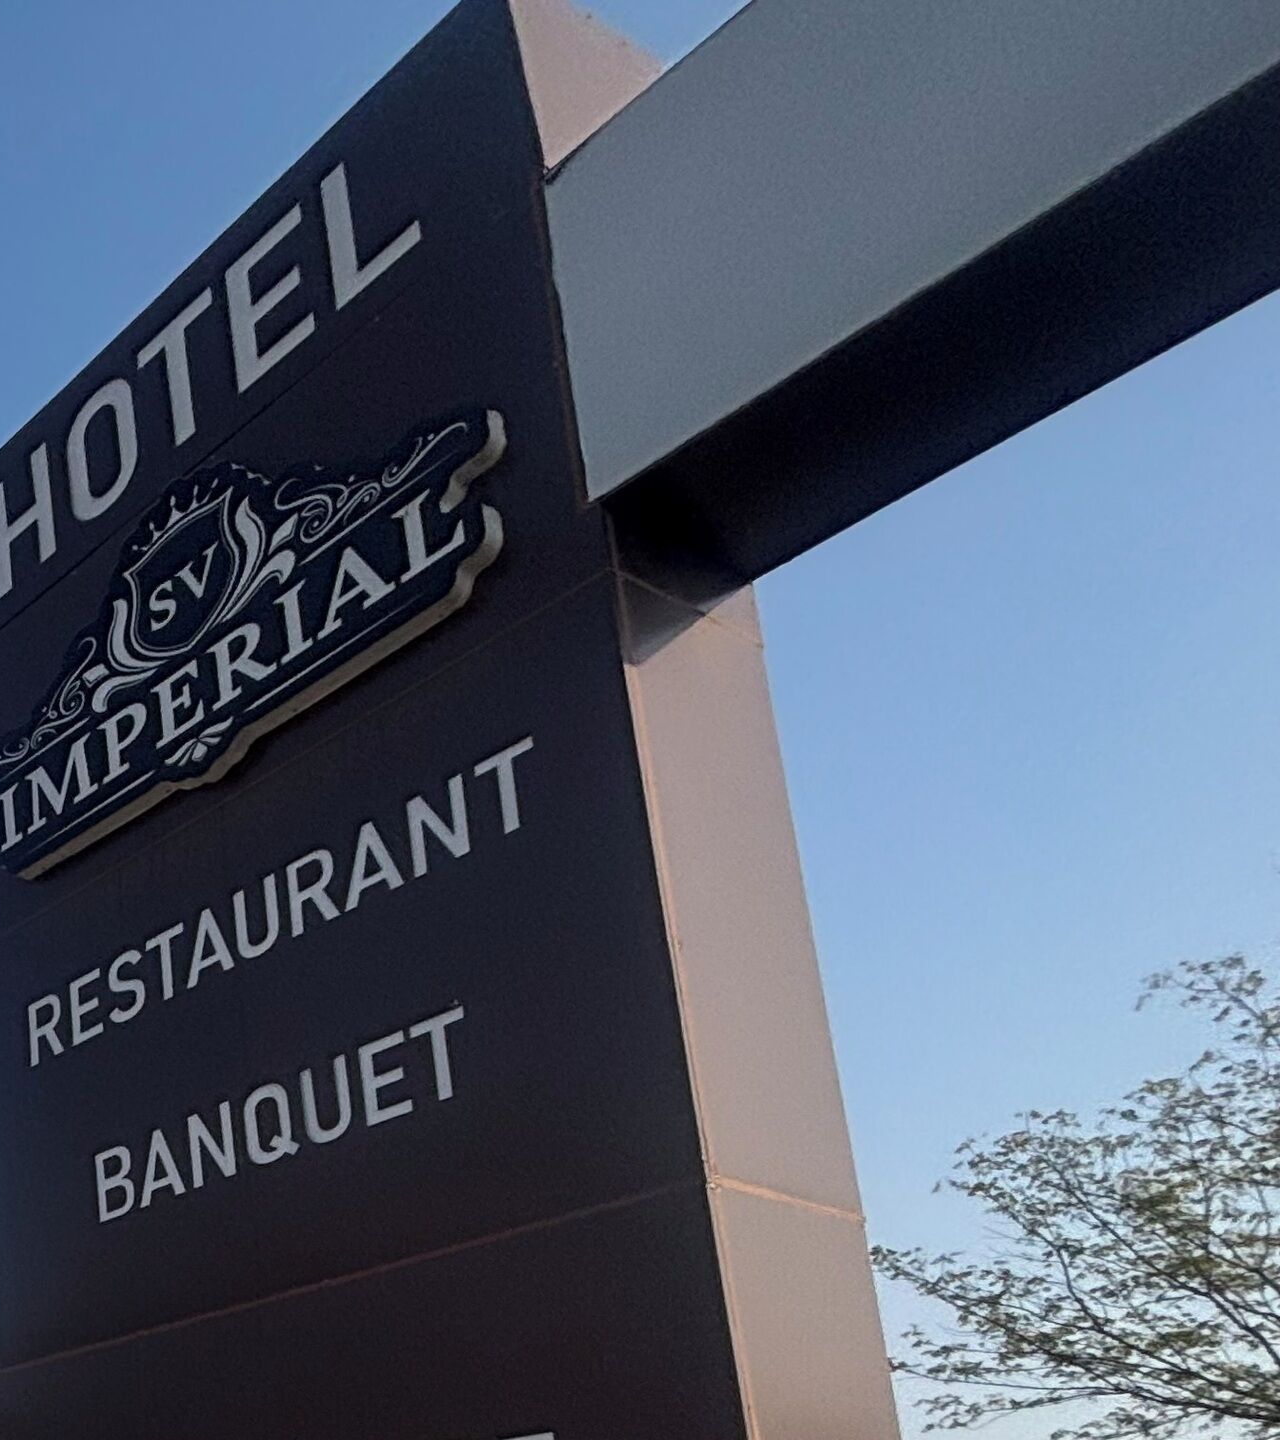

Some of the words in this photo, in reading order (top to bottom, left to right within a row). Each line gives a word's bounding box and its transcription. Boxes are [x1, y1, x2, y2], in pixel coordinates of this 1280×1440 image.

[147, 542, 222, 634] SV
[26, 736, 535, 1068] RESTAURANT
[93, 1004, 465, 1224] BANQUET
